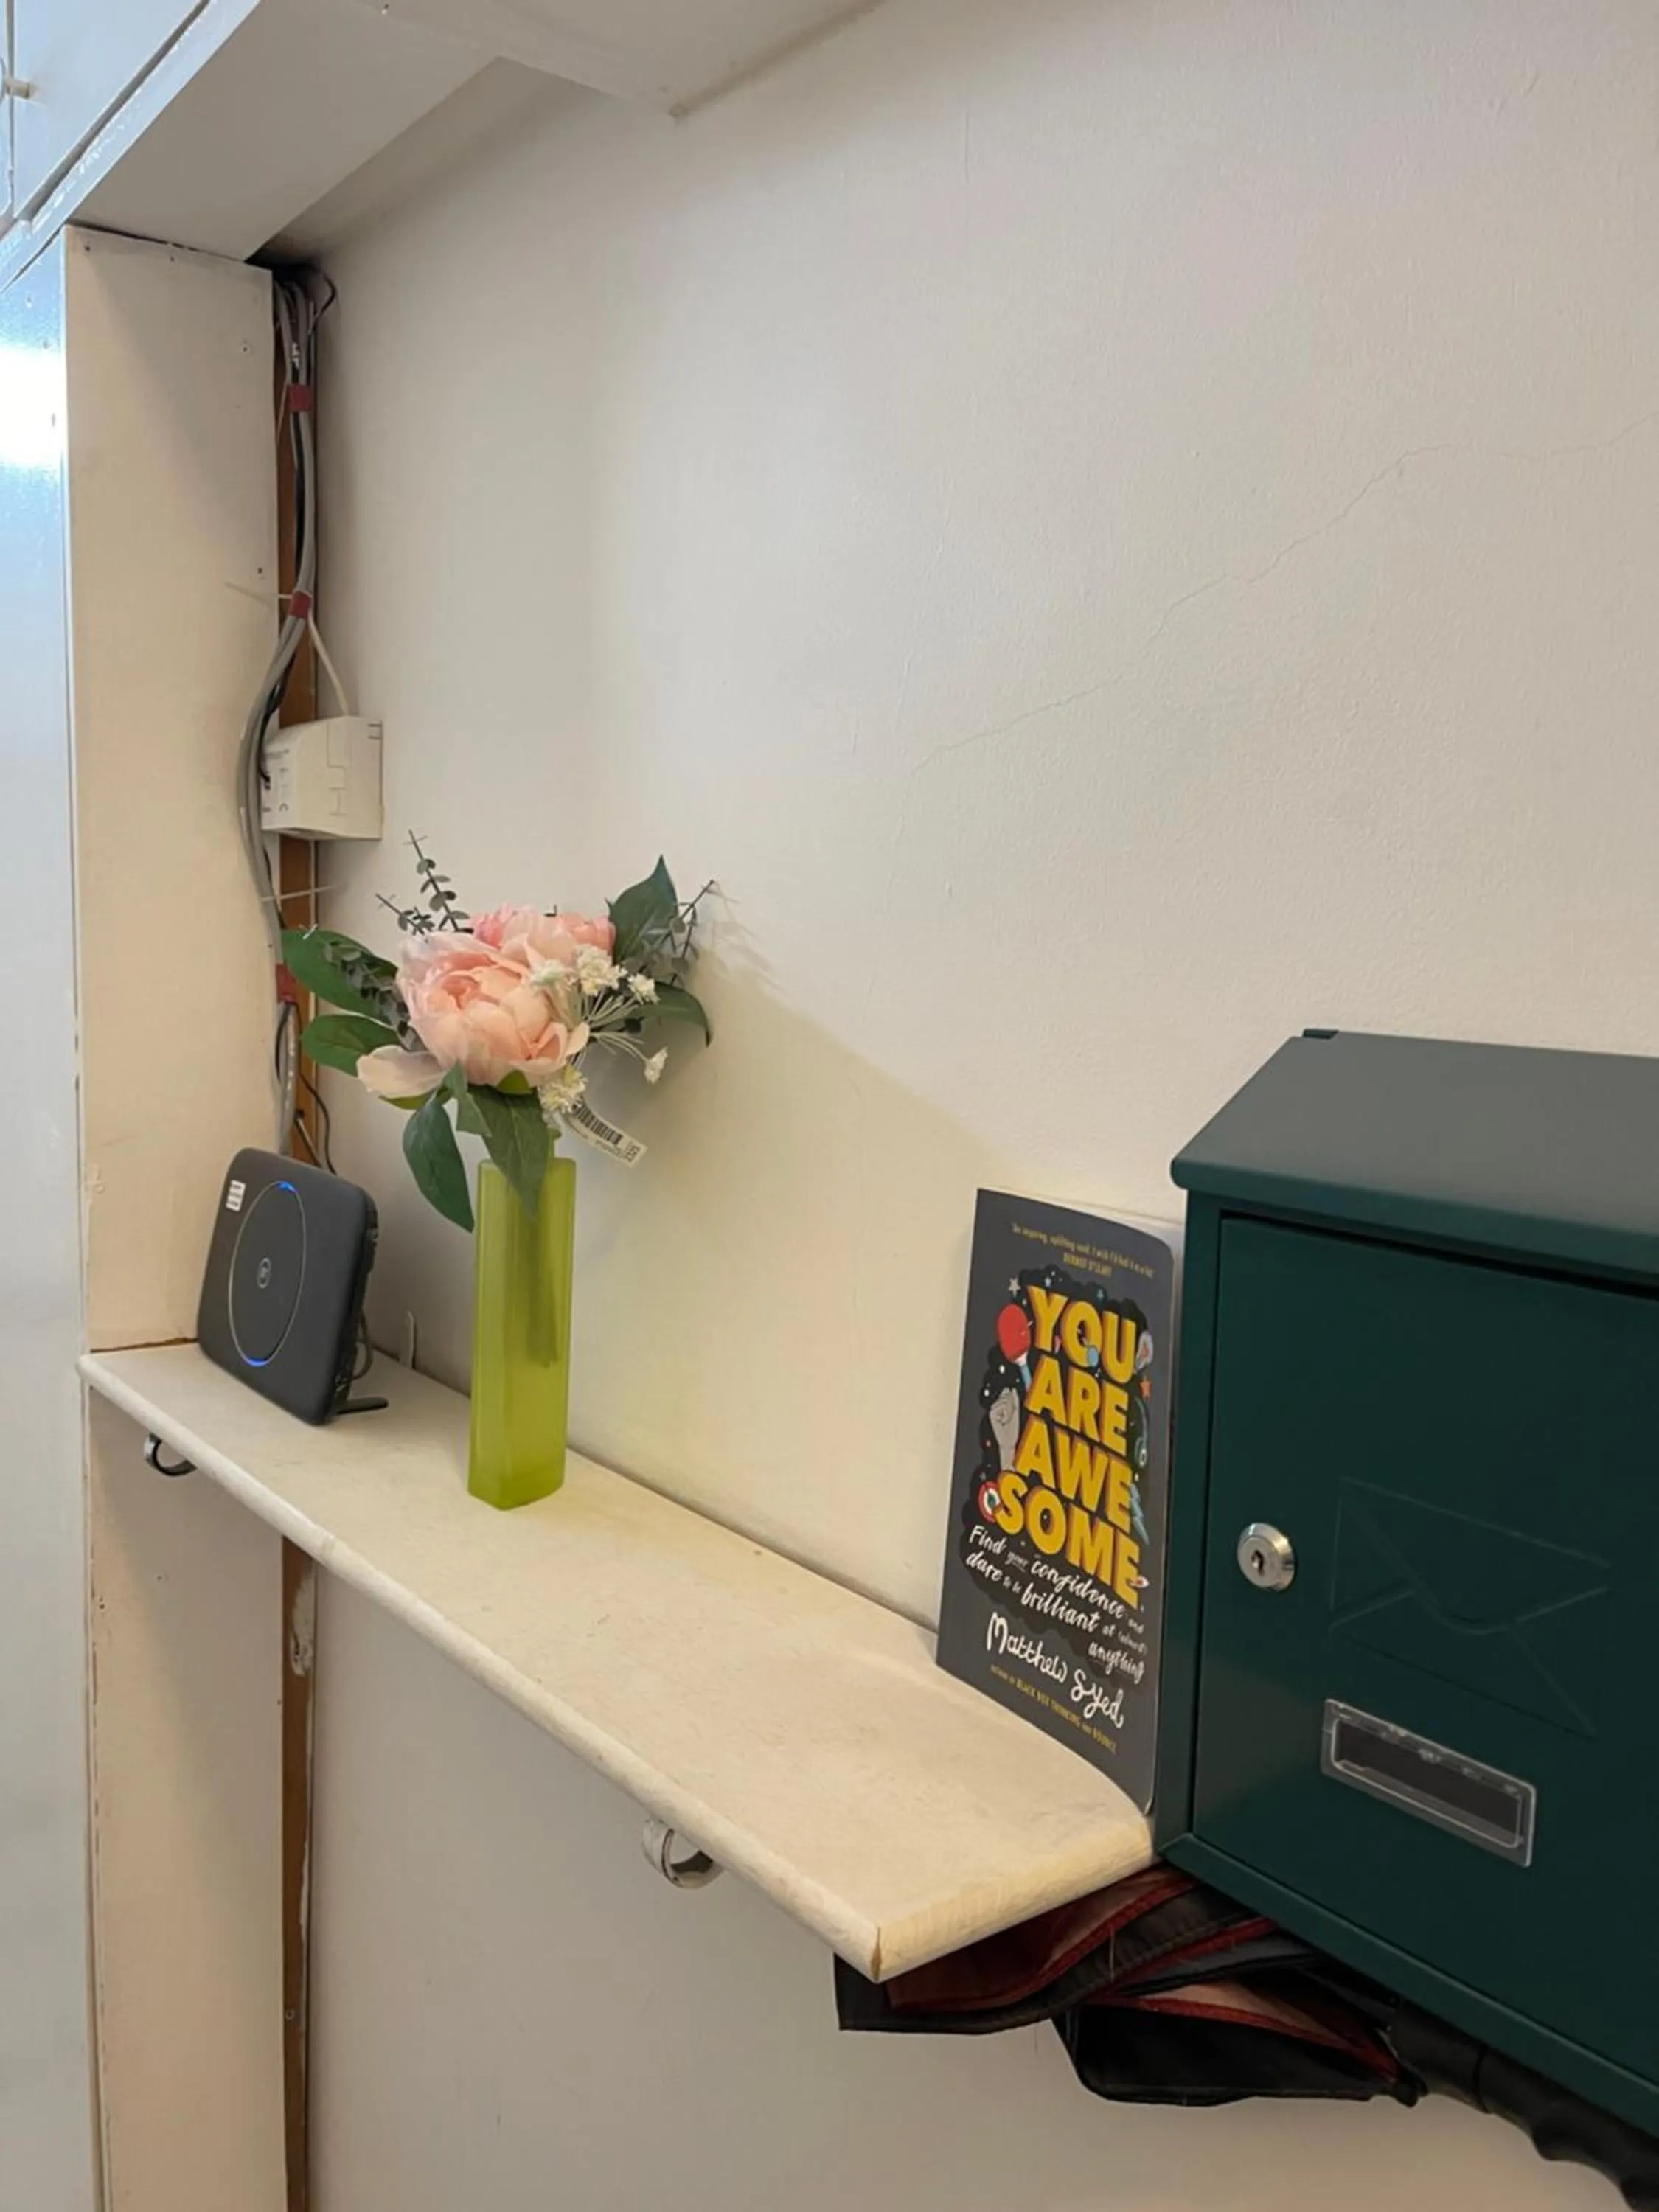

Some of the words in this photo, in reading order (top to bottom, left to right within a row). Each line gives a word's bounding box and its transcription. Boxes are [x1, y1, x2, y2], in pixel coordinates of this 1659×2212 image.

[1027, 1285, 1136, 1383] YOU
[1025, 1355, 1130, 1457] ARE
[1015, 1417, 1133, 1534] AWE
[969, 1524, 1007, 1554] Find
[1031, 1559, 1126, 1619] confidence
[996, 1471, 1140, 1610] SOME
[965, 1551, 1004, 1582] dare
[1020, 1582, 1101, 1632] brilliant
[987, 1612, 1068, 1683] Matthew
[1071, 1669, 1125, 1728] Syed
[1088, 1641, 1145, 1685] anything
